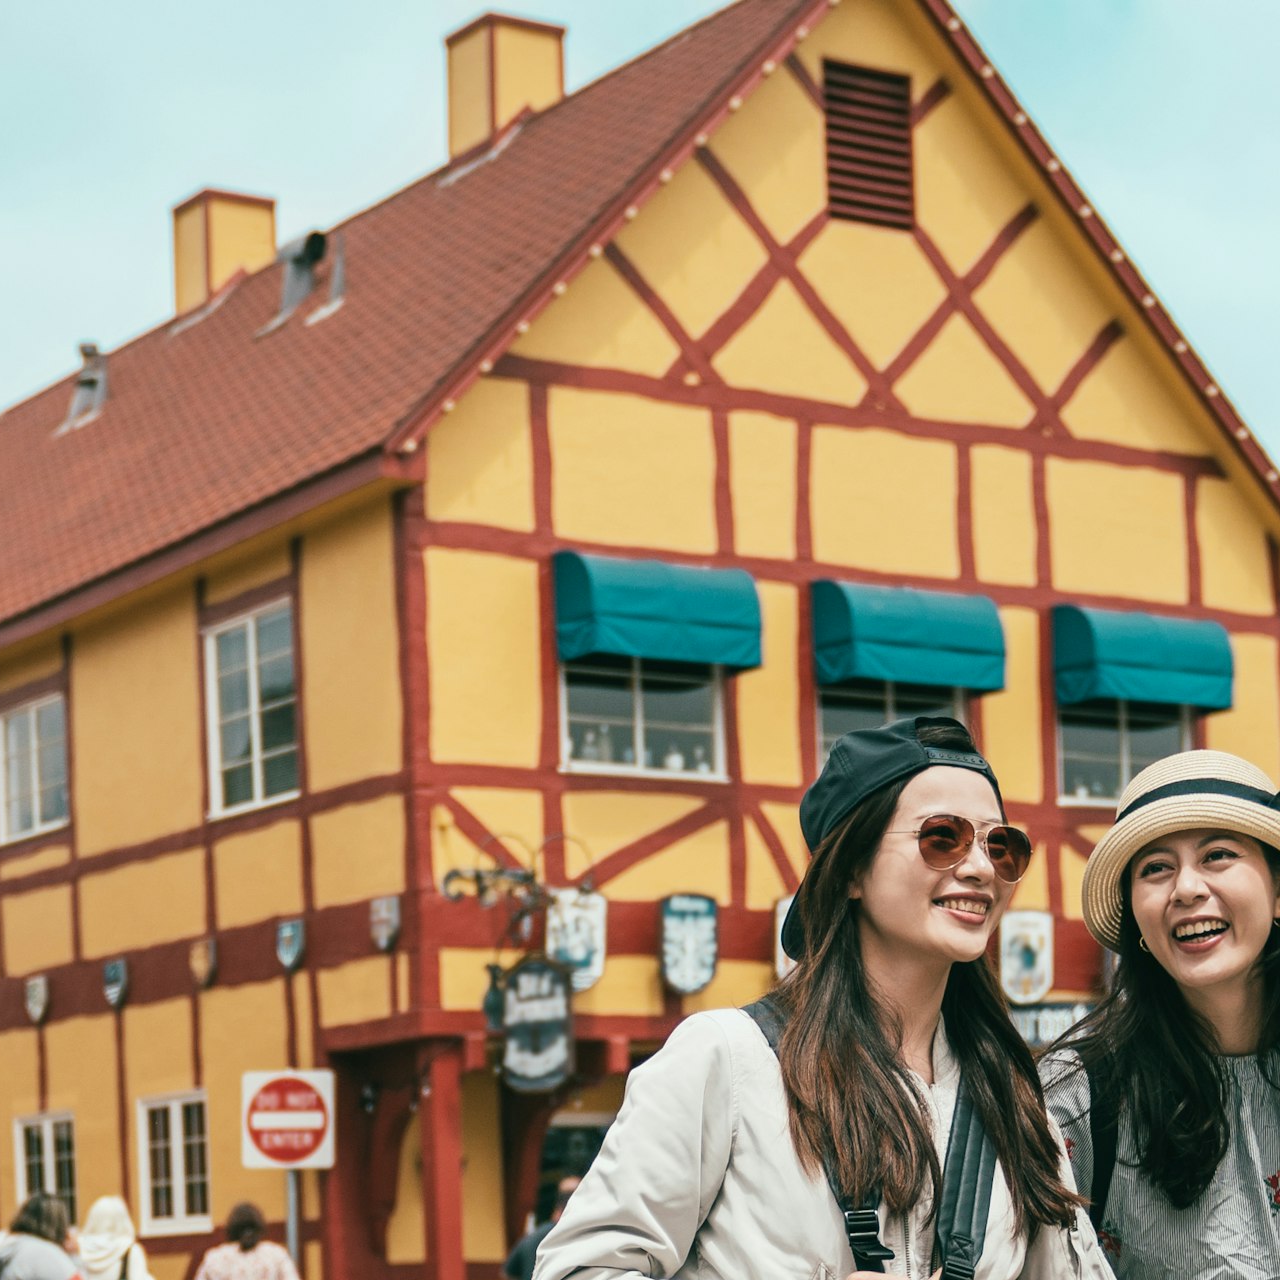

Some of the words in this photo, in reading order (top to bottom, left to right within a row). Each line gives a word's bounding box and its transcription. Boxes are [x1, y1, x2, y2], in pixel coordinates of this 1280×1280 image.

[257, 1092, 279, 1108] DO
[286, 1092, 317, 1107] NOT
[260, 1131, 314, 1149] ENTER
